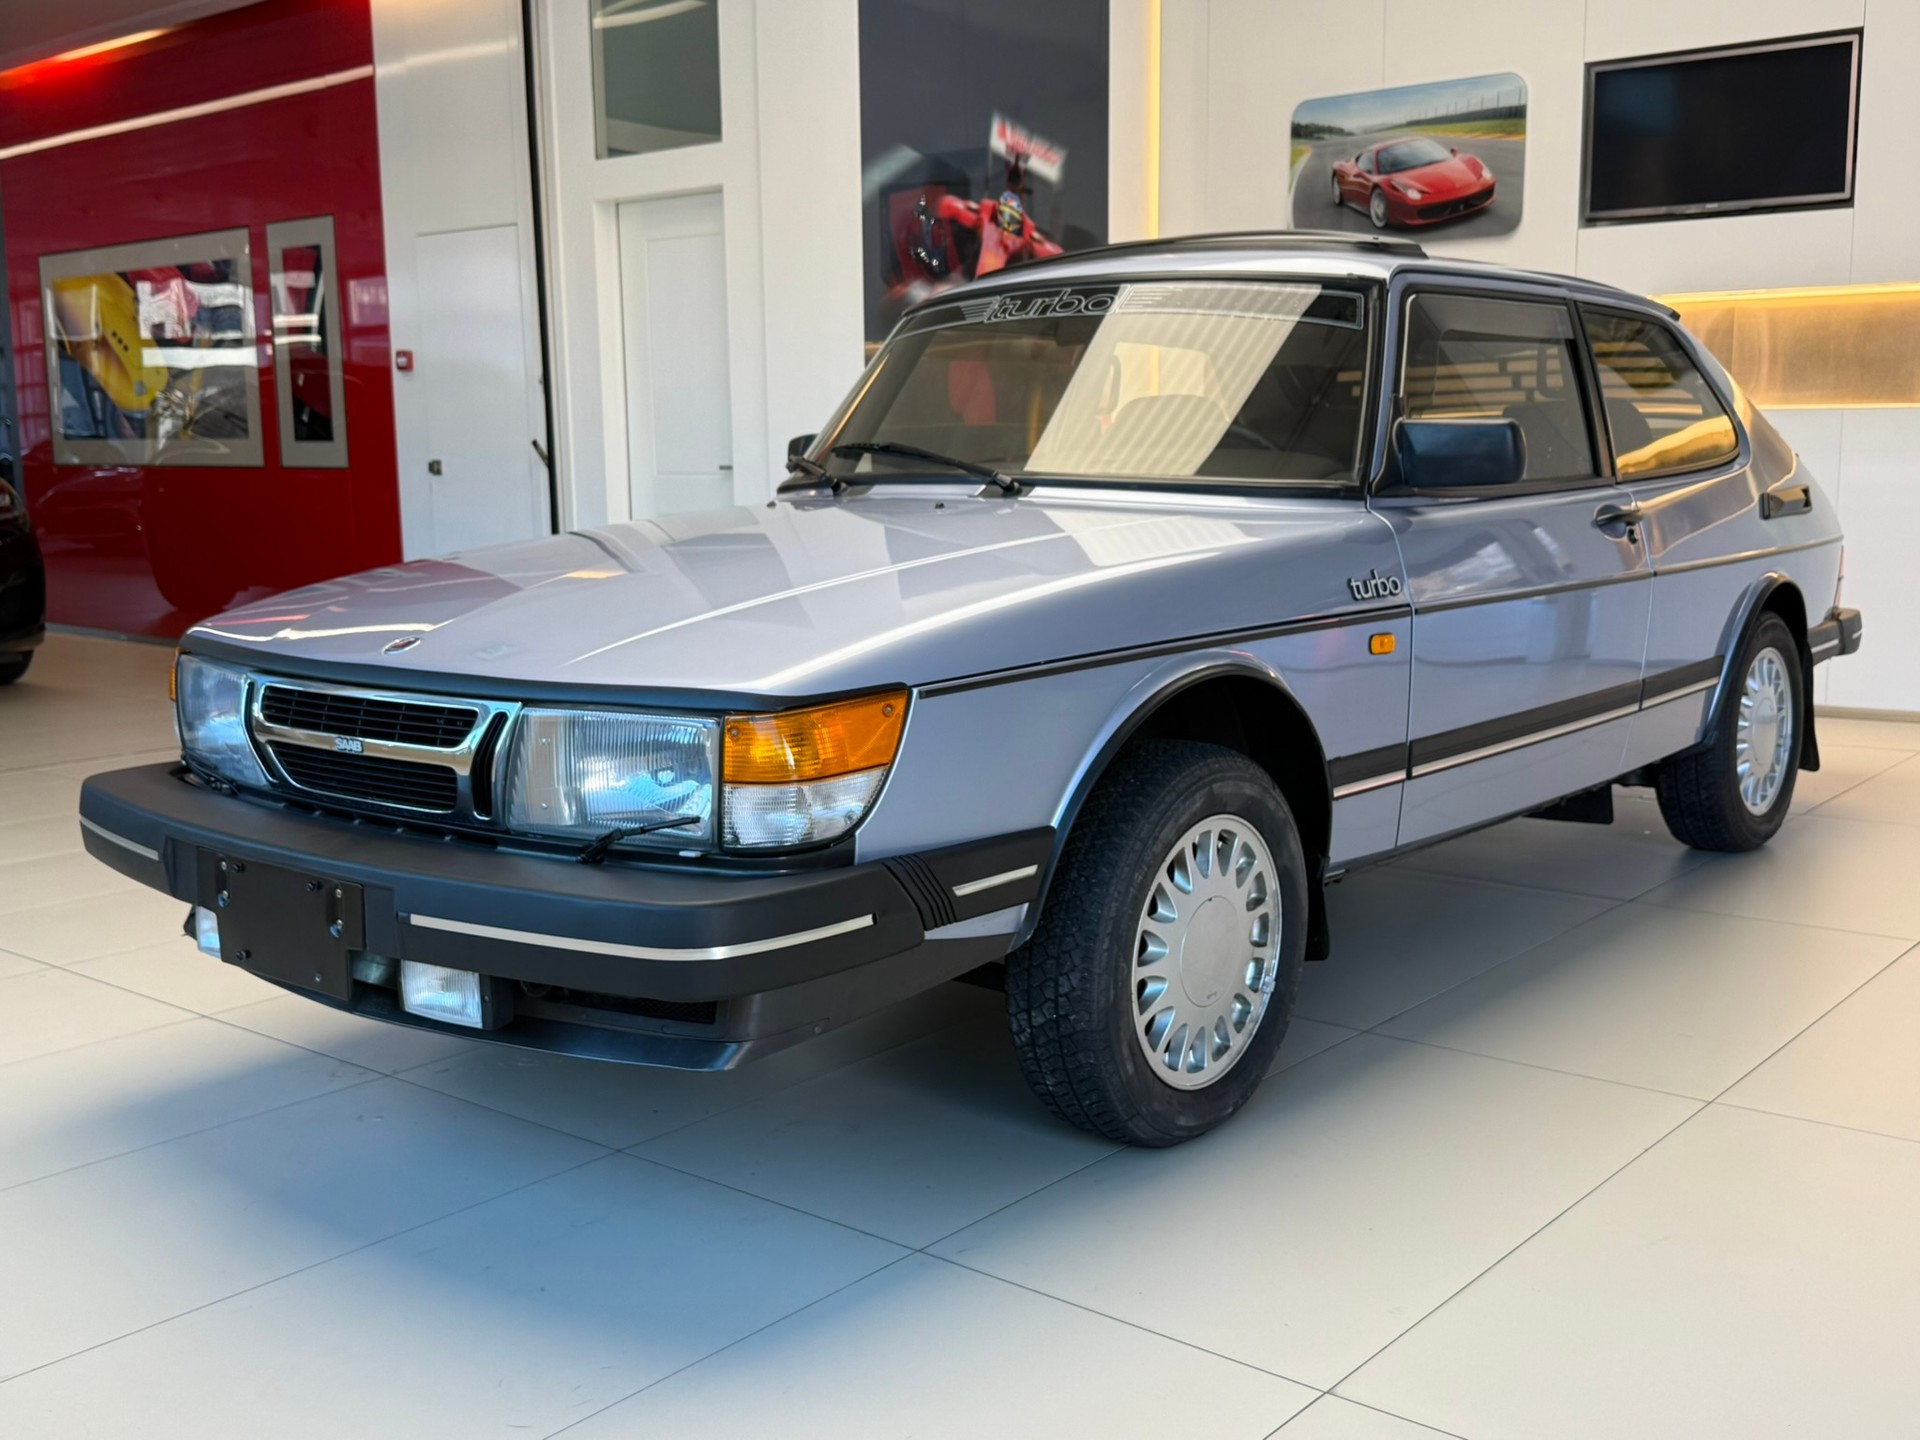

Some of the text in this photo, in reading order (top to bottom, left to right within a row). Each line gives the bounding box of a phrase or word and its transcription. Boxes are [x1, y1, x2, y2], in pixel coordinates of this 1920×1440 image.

[991, 288, 1118, 321] turbo
[1347, 569, 1401, 601] turbo
[335, 736, 363, 753] SAAB
